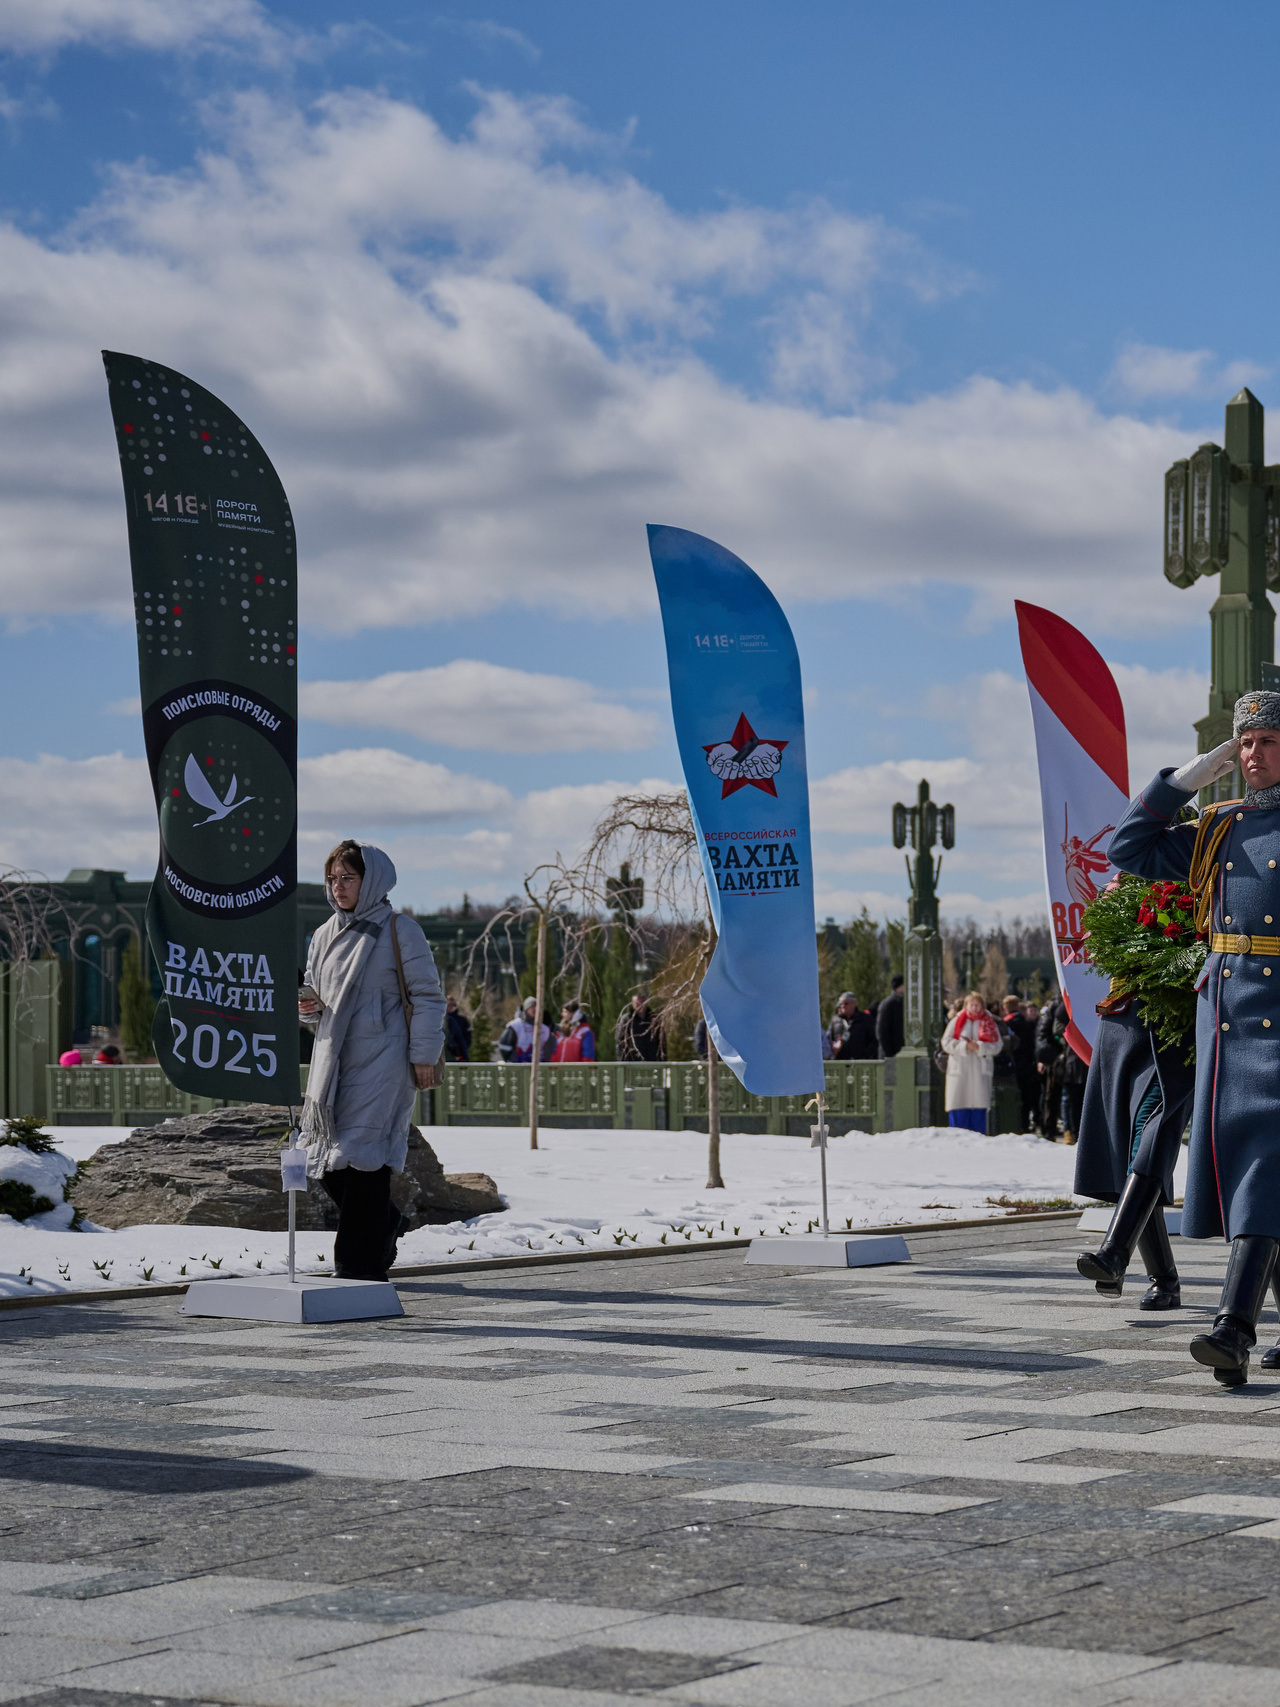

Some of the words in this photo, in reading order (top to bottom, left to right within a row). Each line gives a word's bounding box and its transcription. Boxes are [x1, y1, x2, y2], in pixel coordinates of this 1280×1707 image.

[216, 499, 258, 512] ДОРОГА
[217, 510, 261, 524] ПАМЯТИ
[162, 690, 230, 720] ПОИСКОВЫЕ
[231, 694, 282, 731] ОТРЯДЫ
[704, 828, 797, 841] ВСЕРОССИЙСКАЯ
[708, 842, 799, 870] ВАХТА
[164, 865, 234, 909] МОСКОВСКОЙ
[235, 875, 285, 908] ОБЛАСТИ
[1052, 901, 1086, 938] 80
[165, 940, 274, 984] ВАХТА
[164, 971, 275, 1012] ПАМЯТИ
[170, 1017, 278, 1077] 2025
